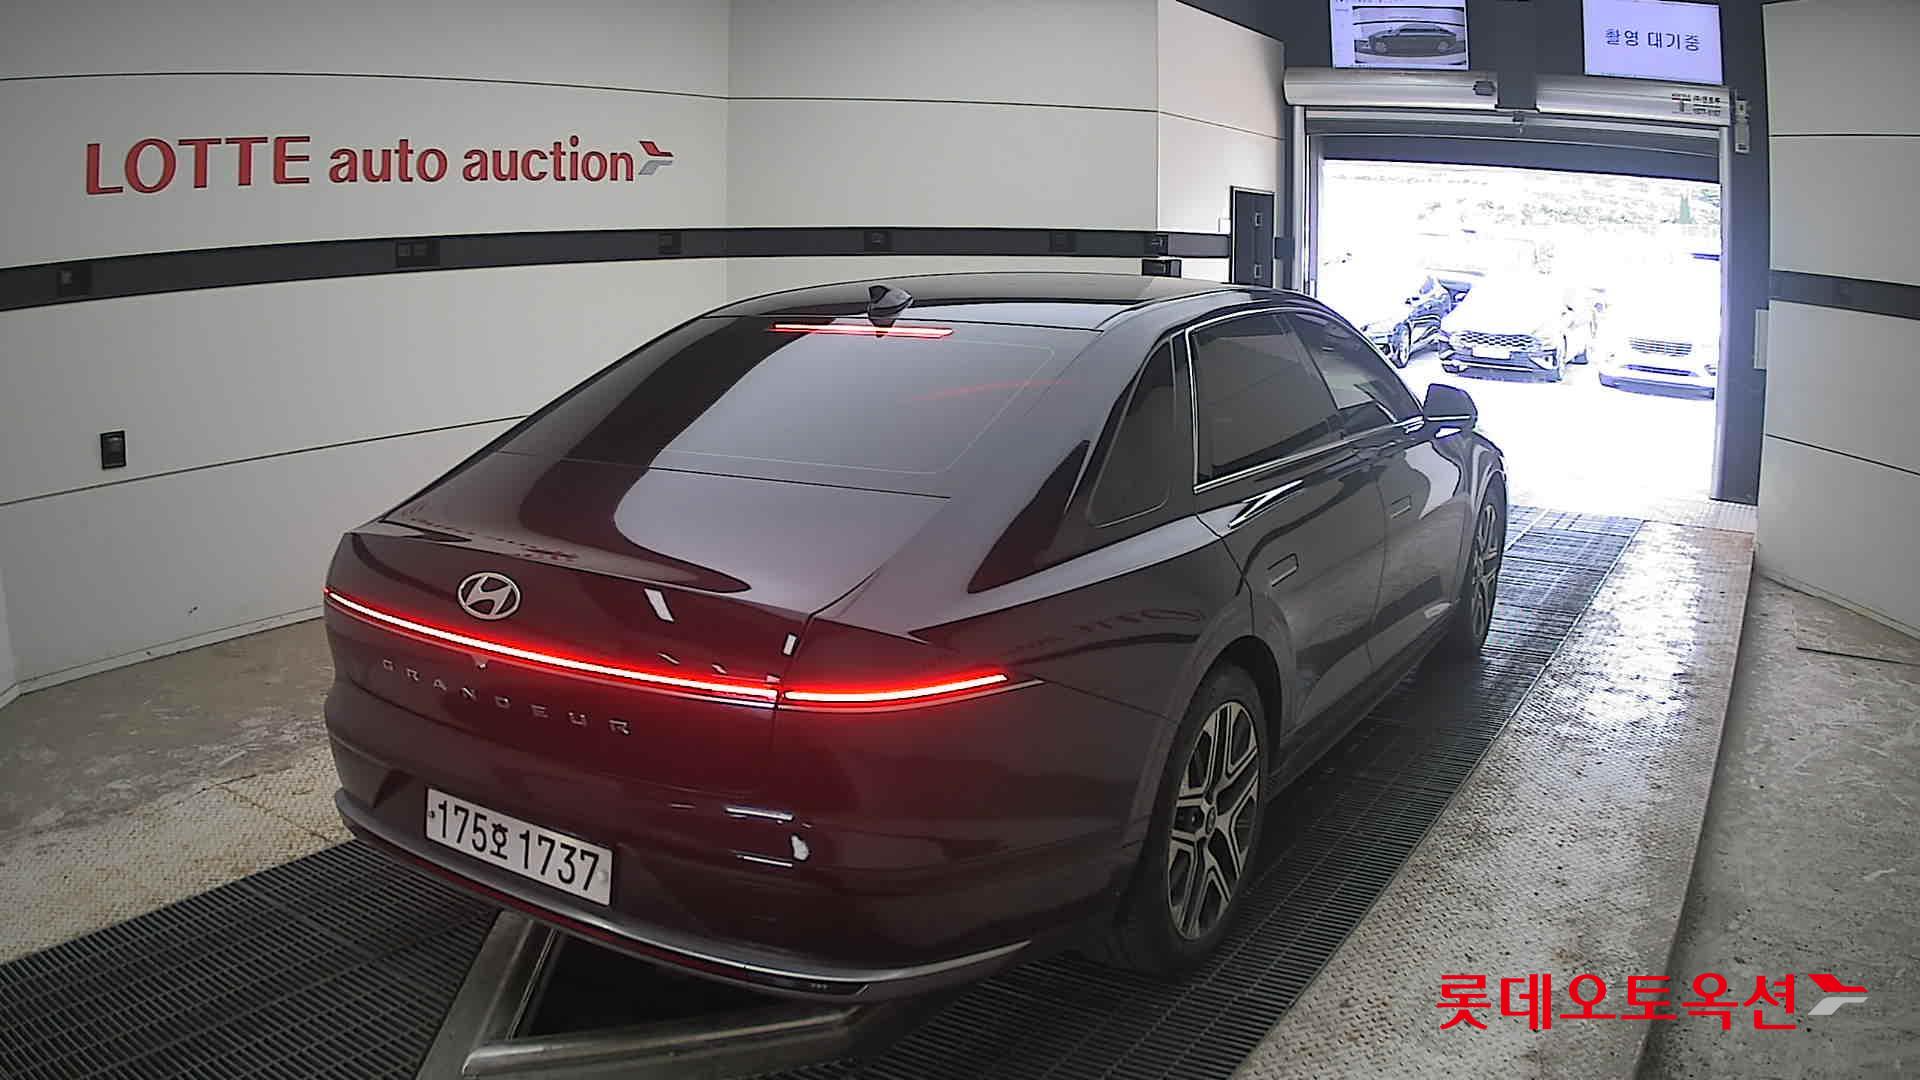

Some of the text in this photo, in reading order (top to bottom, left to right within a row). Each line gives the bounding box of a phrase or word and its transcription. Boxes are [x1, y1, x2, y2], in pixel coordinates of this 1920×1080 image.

[85, 135, 634, 195] LOTTE auto auction
[382, 658, 631, 736] GRANDEUR
[438, 800, 599, 891] 175호 1737
